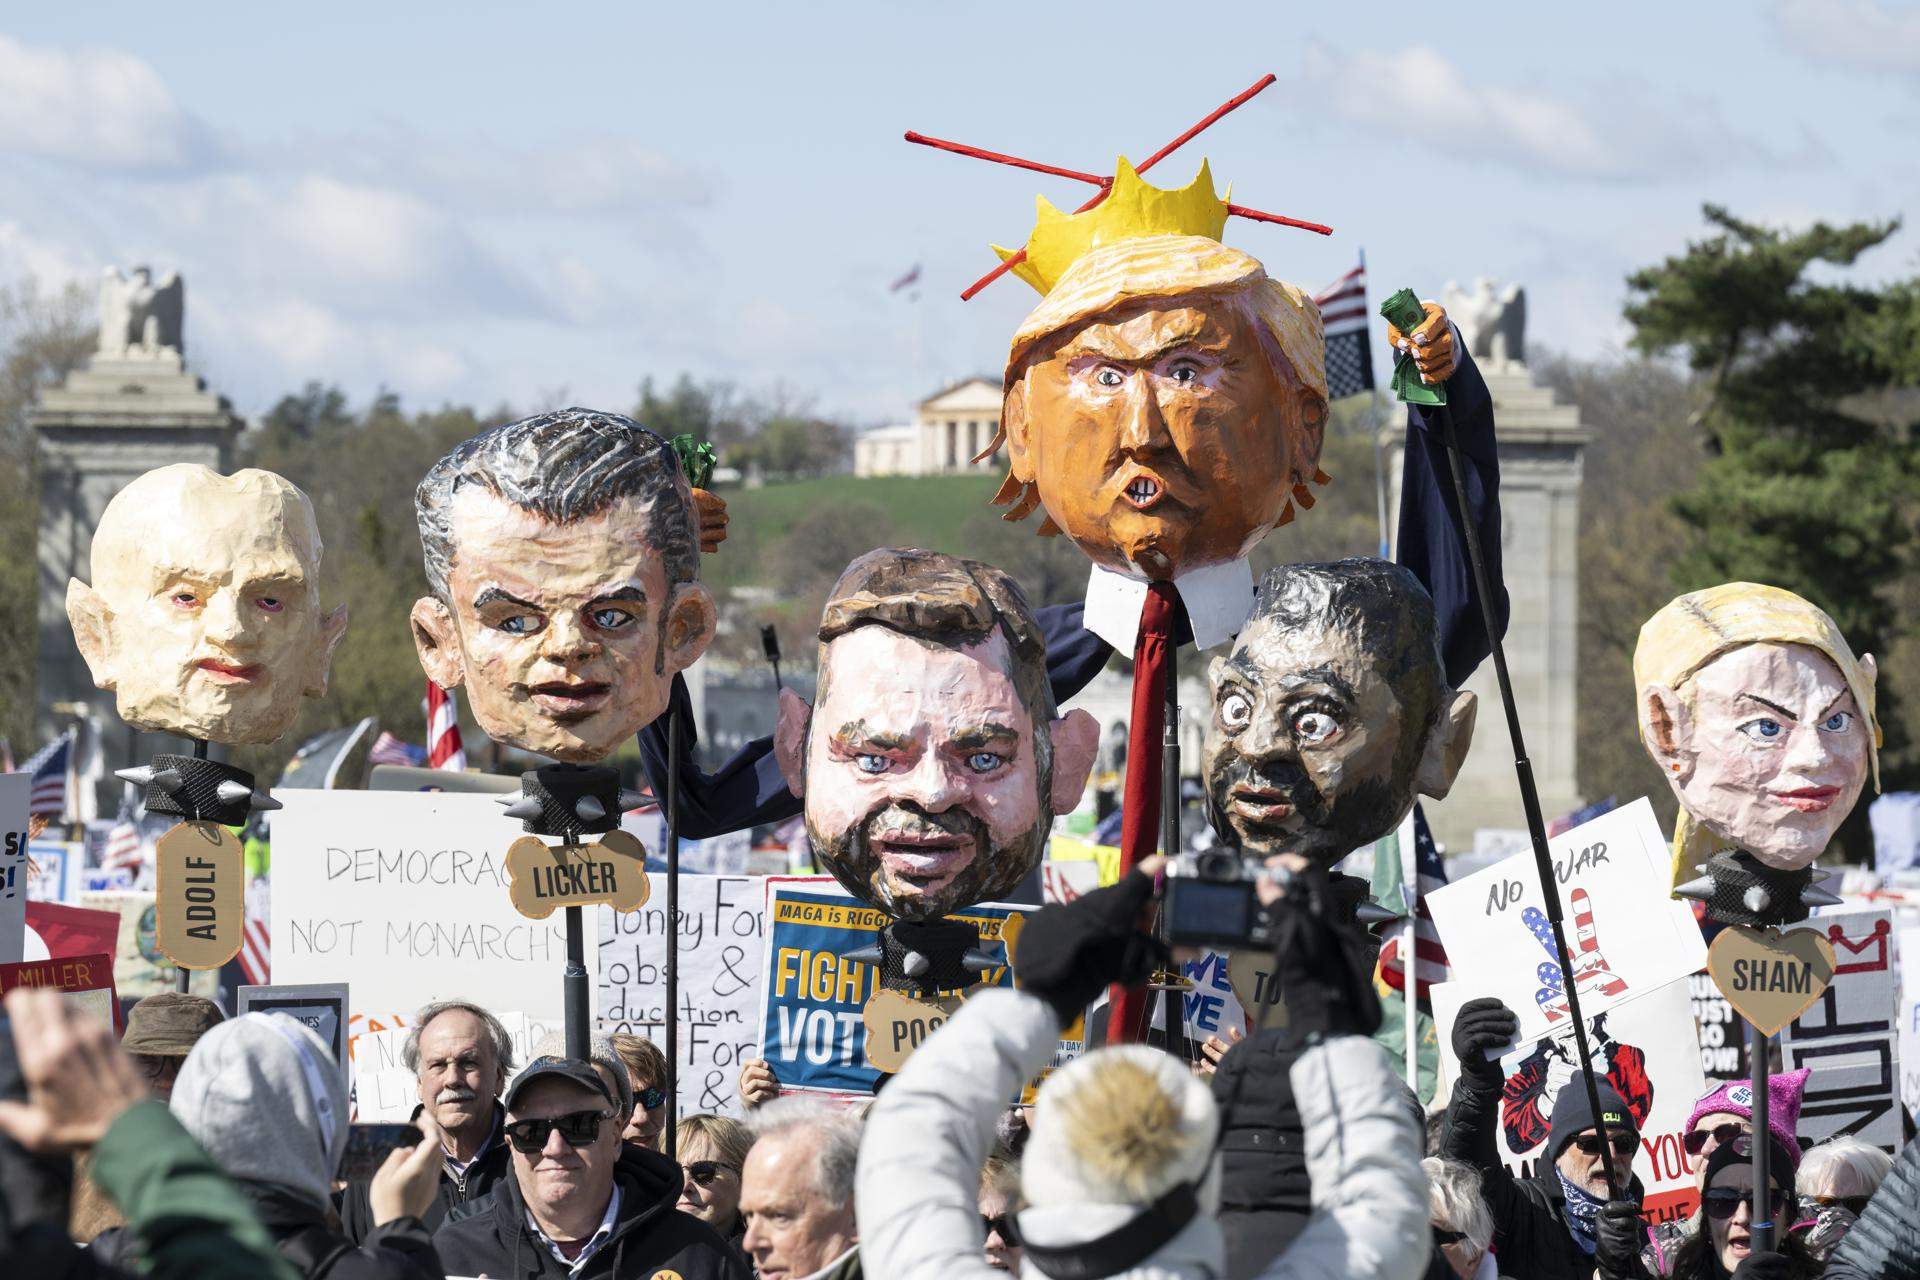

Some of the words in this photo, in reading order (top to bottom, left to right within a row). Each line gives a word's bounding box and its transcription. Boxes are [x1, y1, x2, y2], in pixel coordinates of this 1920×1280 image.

[185, 856, 216, 941] ADOLF
[533, 862, 618, 898] LICKER
[1486, 879, 1523, 916] NO
[714, 879, 763, 938] For
[780, 904, 822, 922] MAGA
[828, 908, 841, 922] is
[292, 920, 363, 956] NOT
[713, 945, 757, 996] &
[1733, 959, 1811, 994] SHAM
[689, 1022, 757, 1067] For
[776, 1006, 876, 1070] VOT
